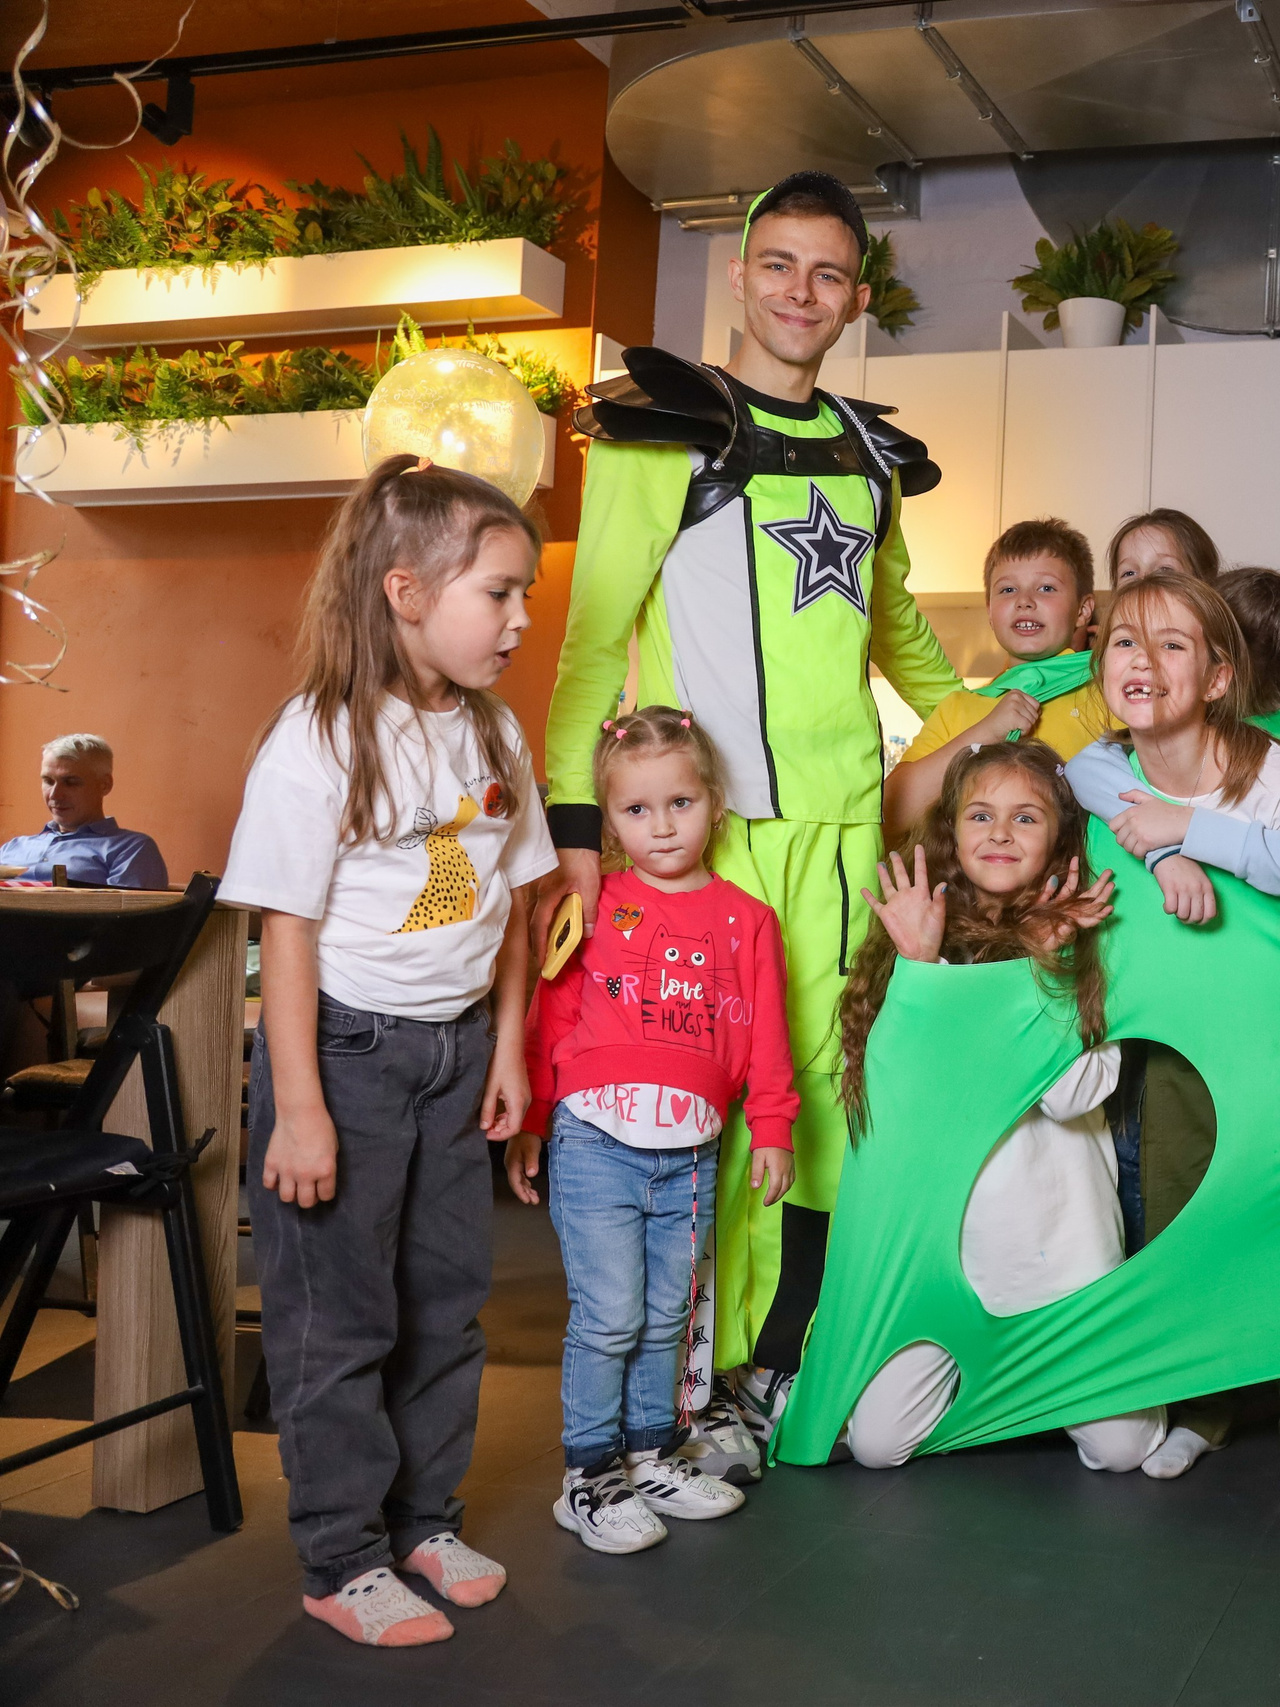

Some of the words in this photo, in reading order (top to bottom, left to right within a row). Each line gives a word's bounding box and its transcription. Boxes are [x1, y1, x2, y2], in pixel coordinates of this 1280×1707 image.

[660, 968, 705, 1001] love
[661, 1007, 704, 1038] HUGS
[716, 991, 752, 1026] YOU
